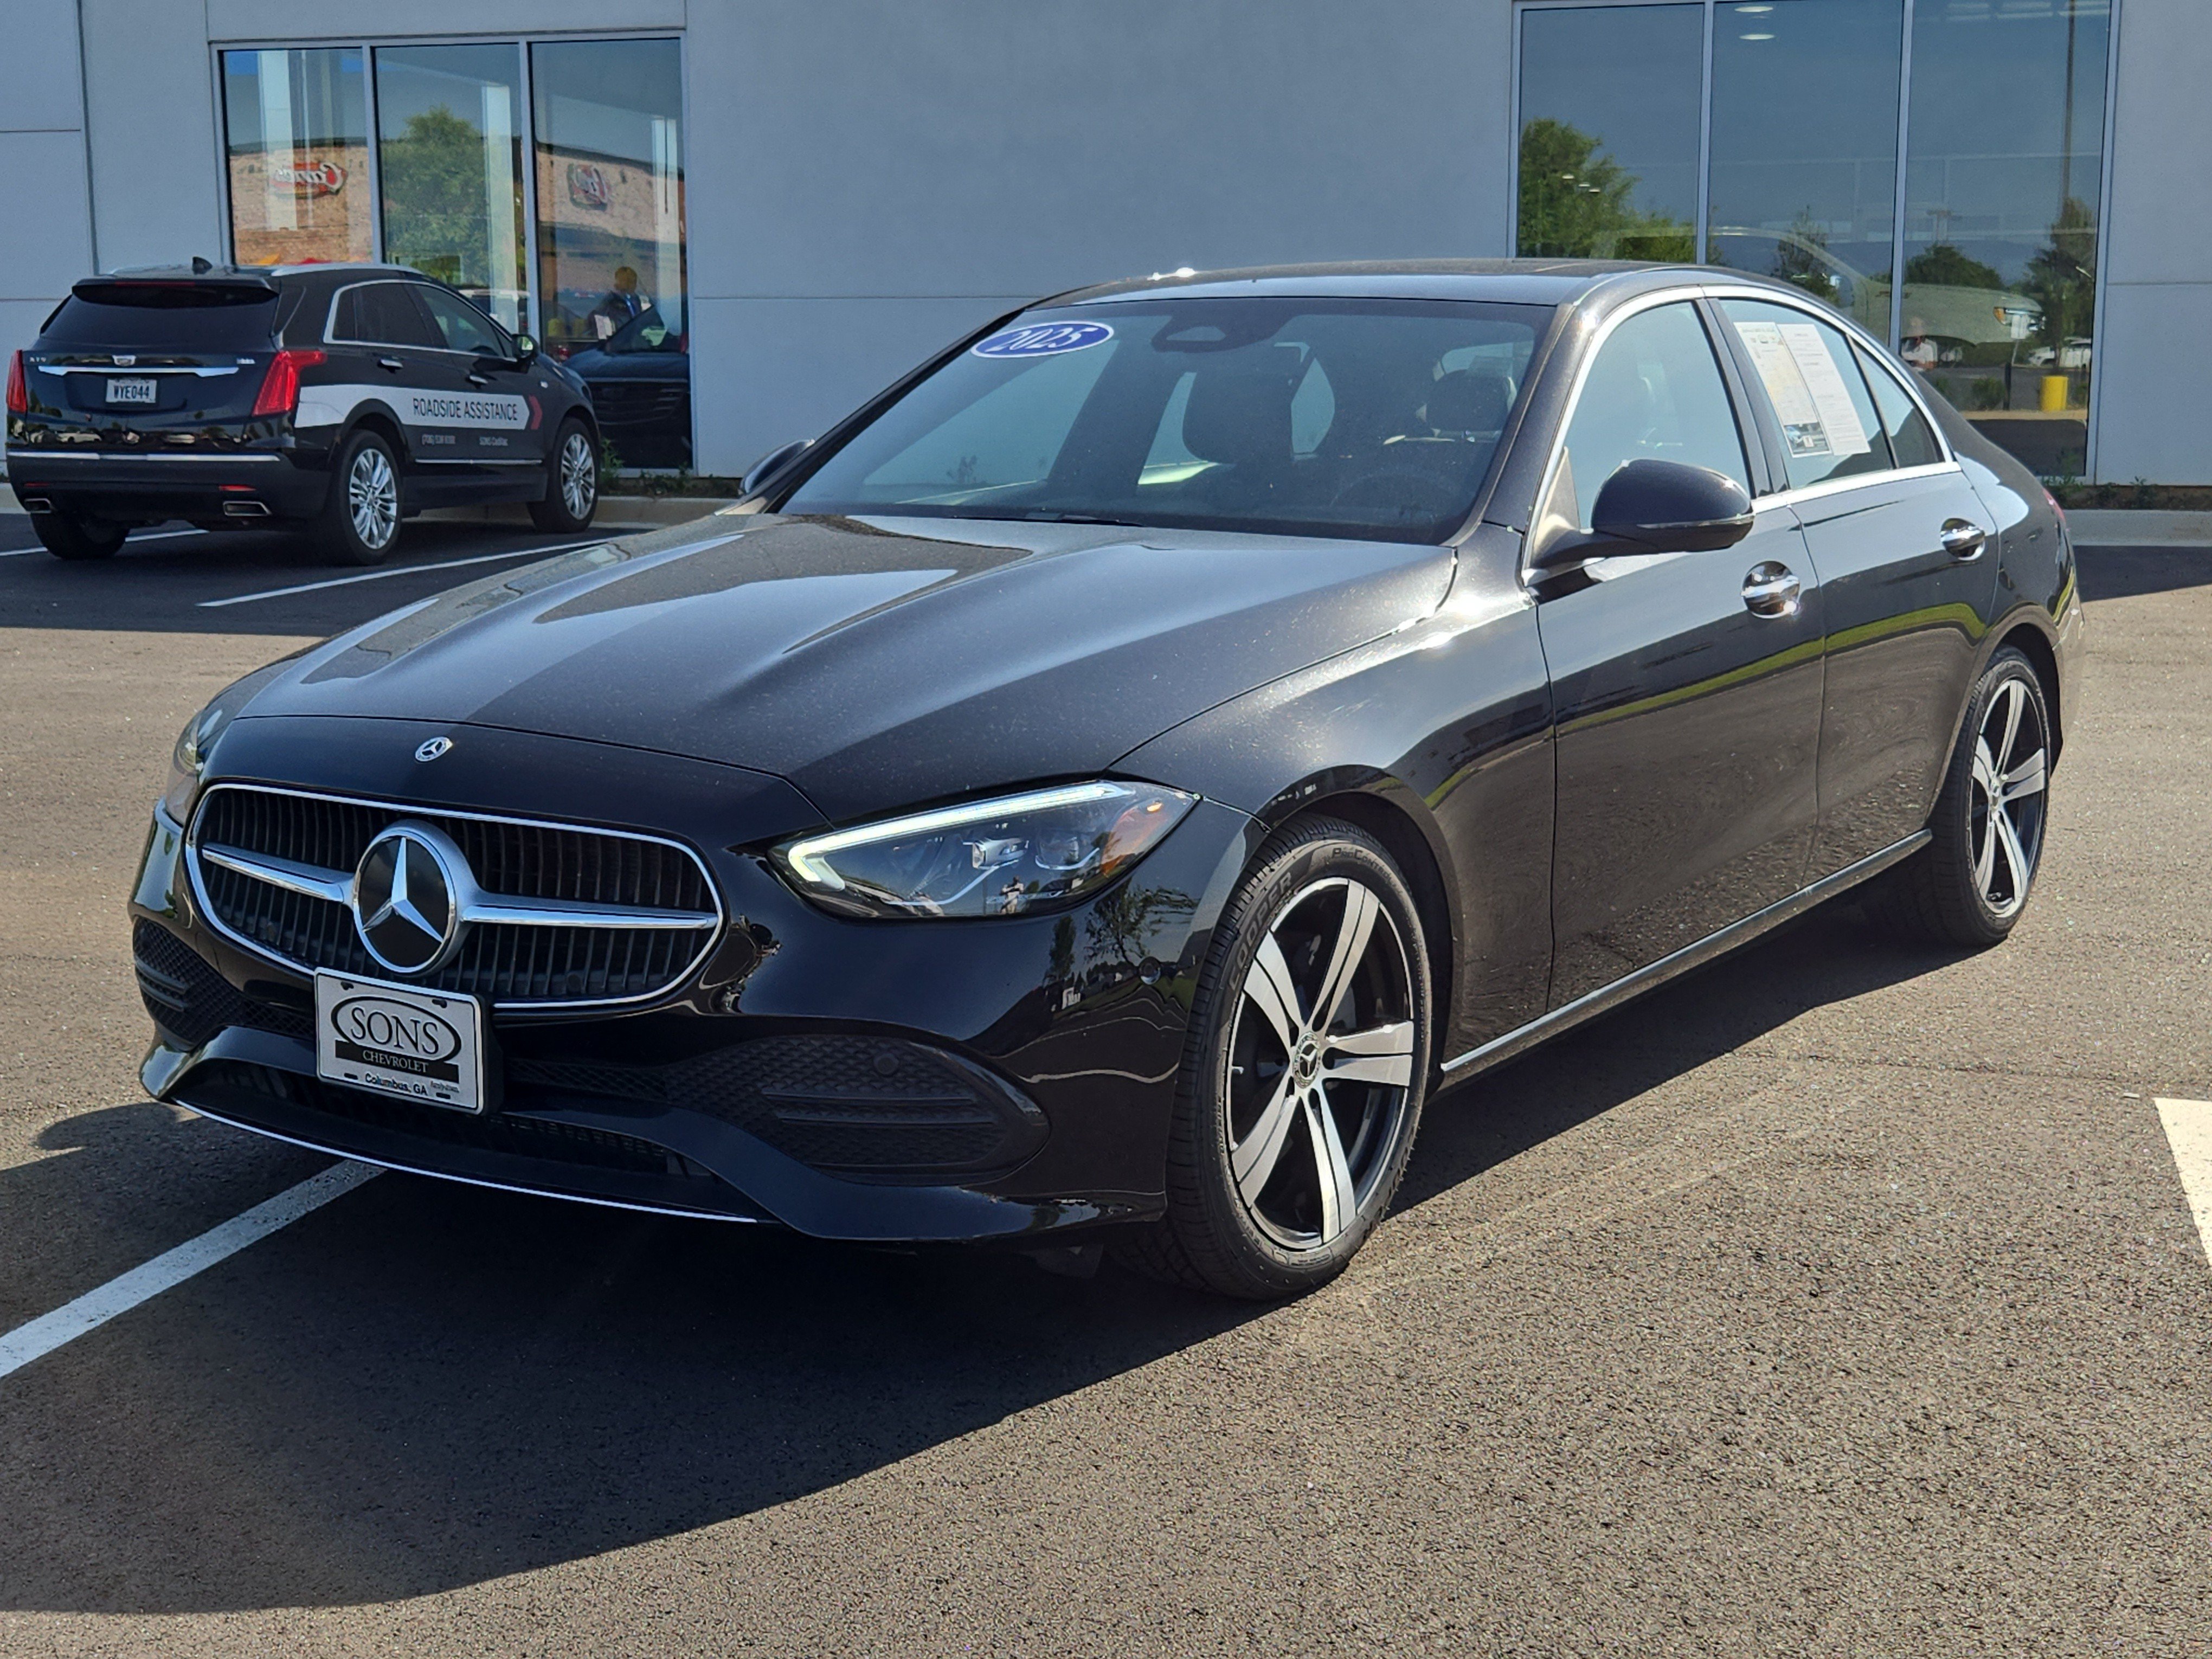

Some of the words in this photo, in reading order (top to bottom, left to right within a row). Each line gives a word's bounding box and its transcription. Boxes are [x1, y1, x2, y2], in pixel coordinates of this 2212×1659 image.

[985, 327, 1099, 353] 2025
[413, 397, 461, 419] ROADSIDE
[464, 401, 518, 421] ASSISTANCE
[1227, 871, 1292, 991] COOPER
[350, 1007, 439, 1054] SONS
[362, 1049, 429, 1073] CHEVROLET
[413, 1083, 428, 1096] GA
